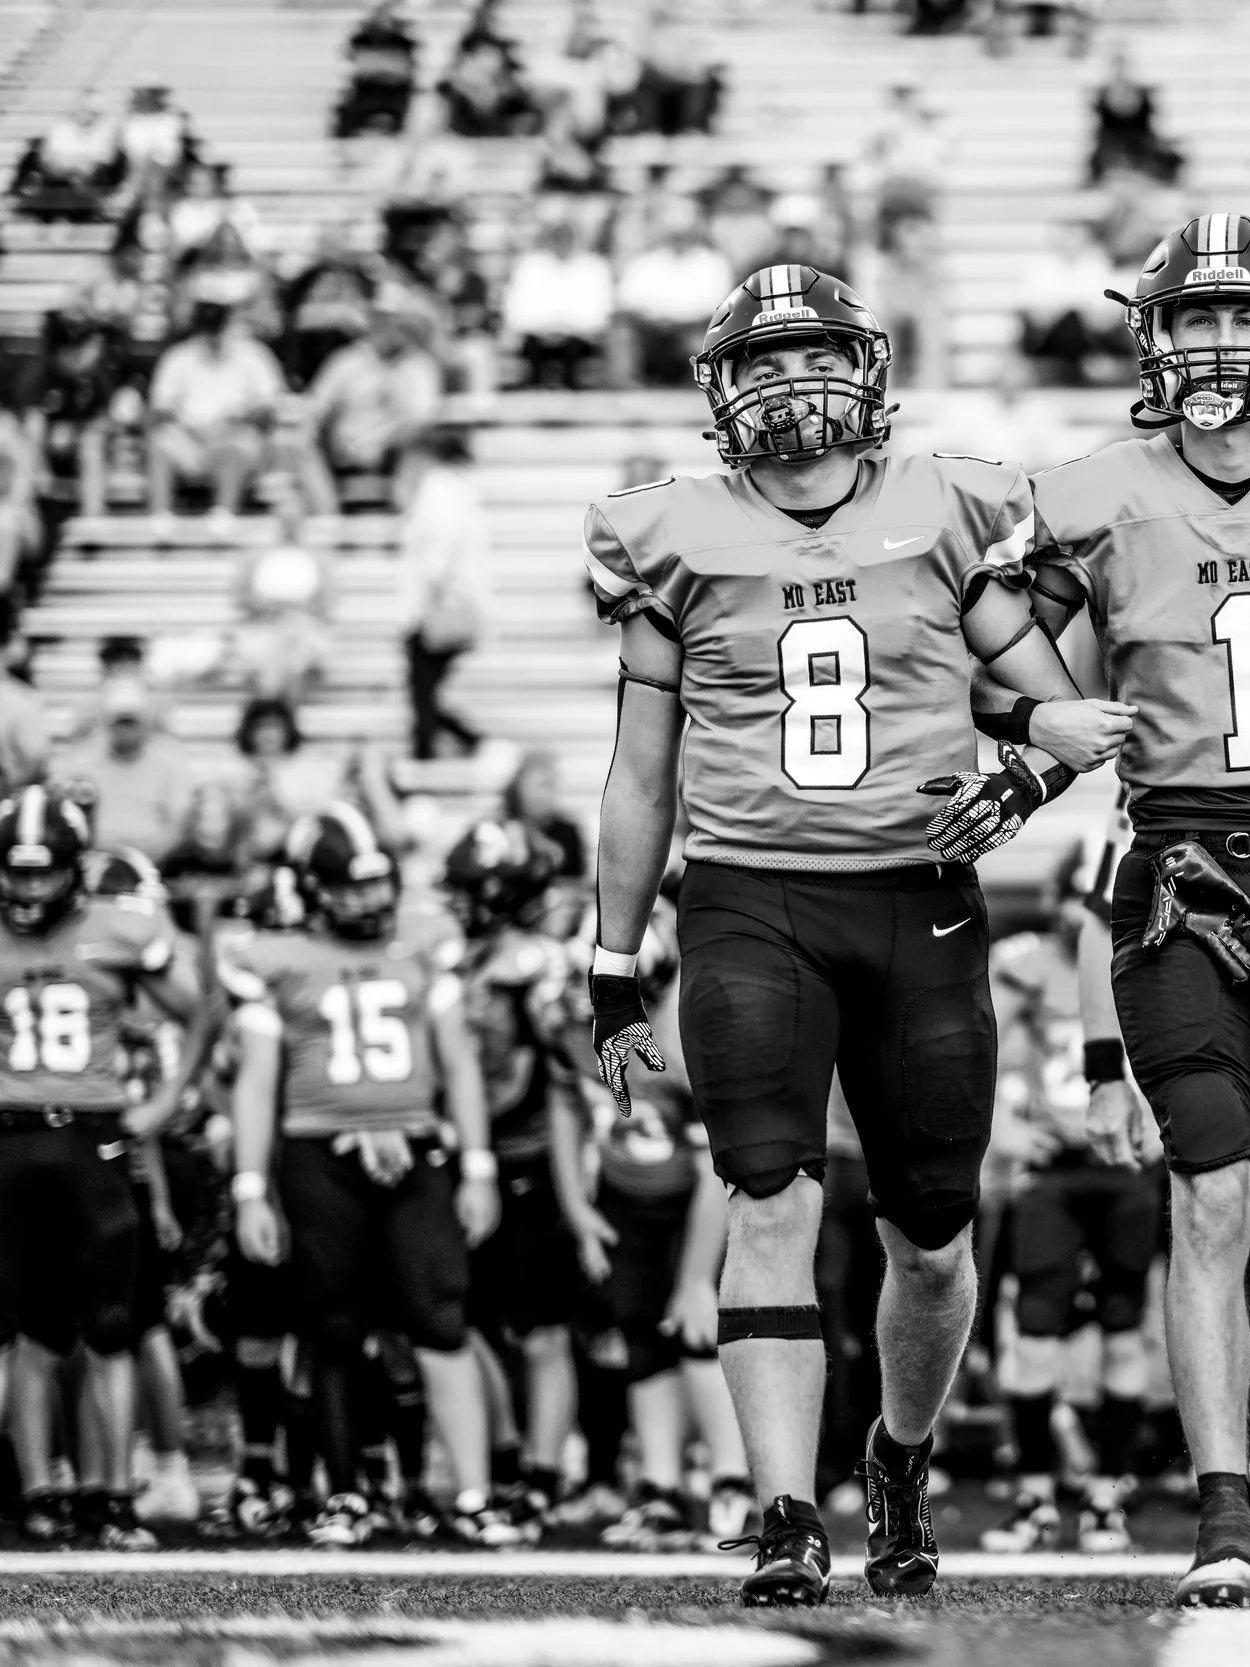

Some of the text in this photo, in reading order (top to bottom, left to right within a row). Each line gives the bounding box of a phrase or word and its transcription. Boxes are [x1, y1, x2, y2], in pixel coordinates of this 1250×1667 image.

[1192, 268, 1244, 282] Riddell
[1197, 559, 1219, 584] MO
[781, 578, 857, 610] MO EAST
[777, 615, 870, 790] 8
[320, 979, 412, 1084] 15
